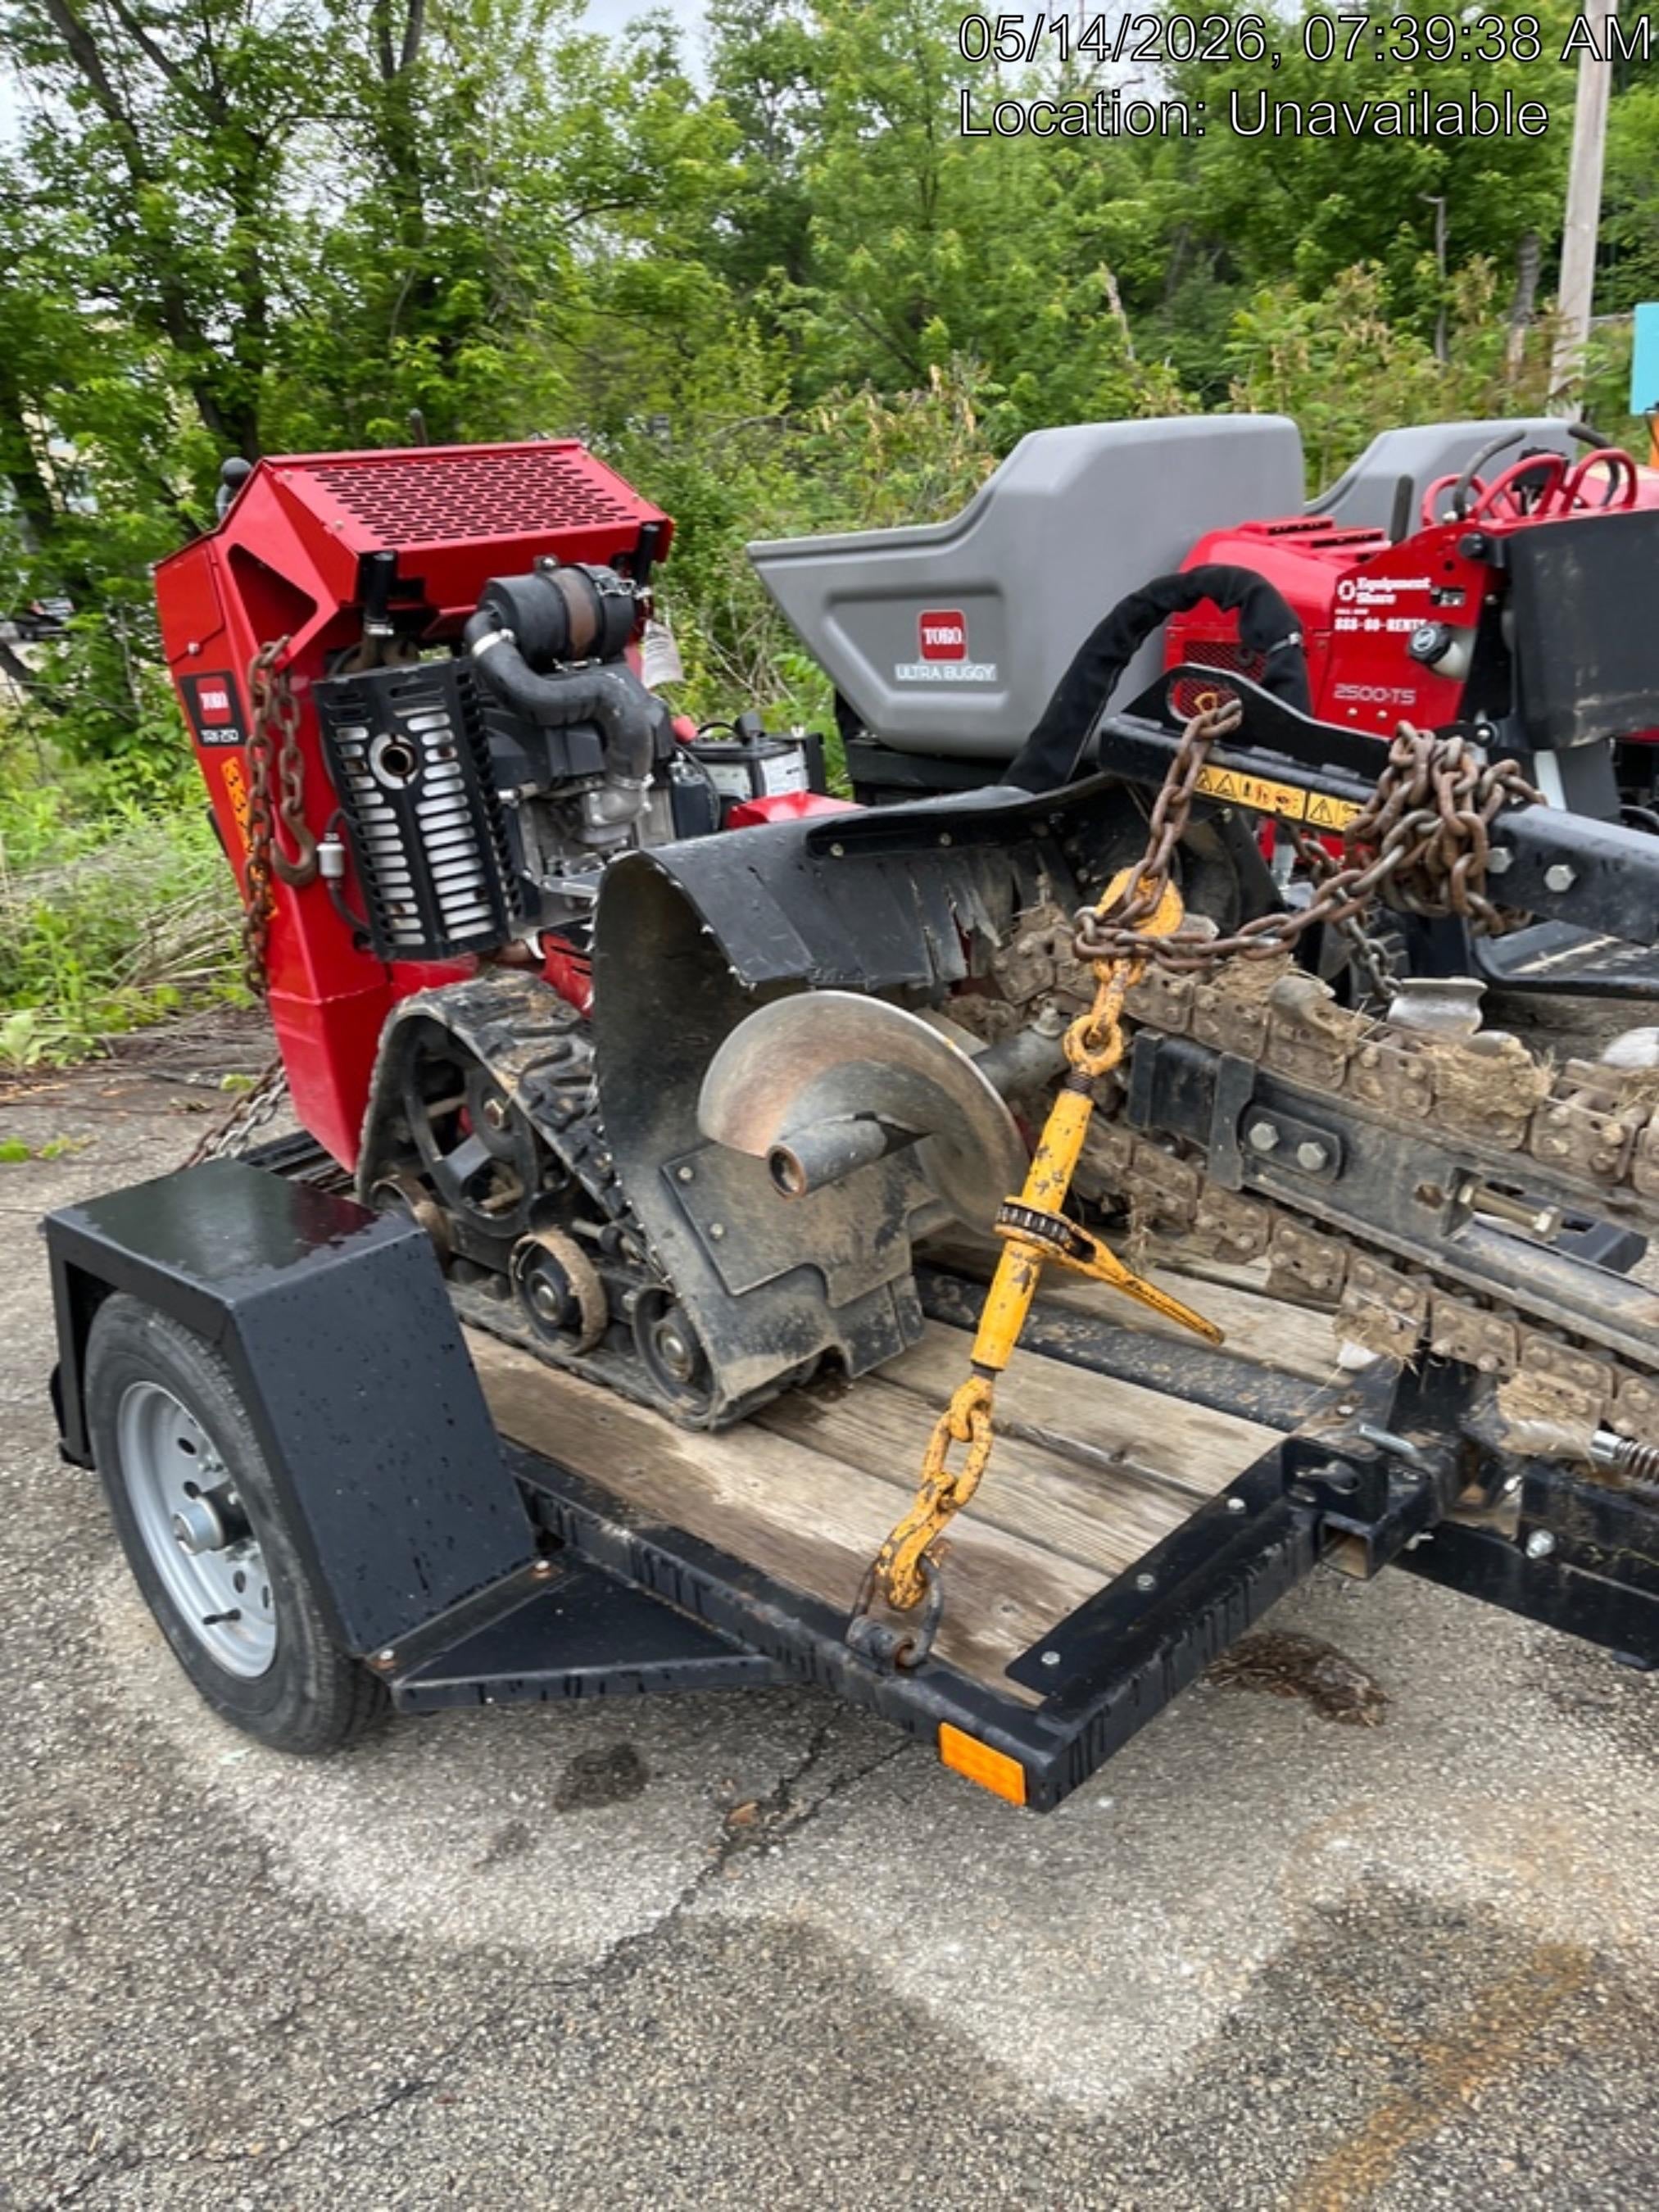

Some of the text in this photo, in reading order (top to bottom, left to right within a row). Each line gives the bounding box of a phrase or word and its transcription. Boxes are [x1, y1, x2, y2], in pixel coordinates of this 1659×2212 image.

[1357, 577, 1430, 592] Equipment
[923, 627, 963, 645] TORO
[896, 664, 996, 681] ULTRA BUGGY
